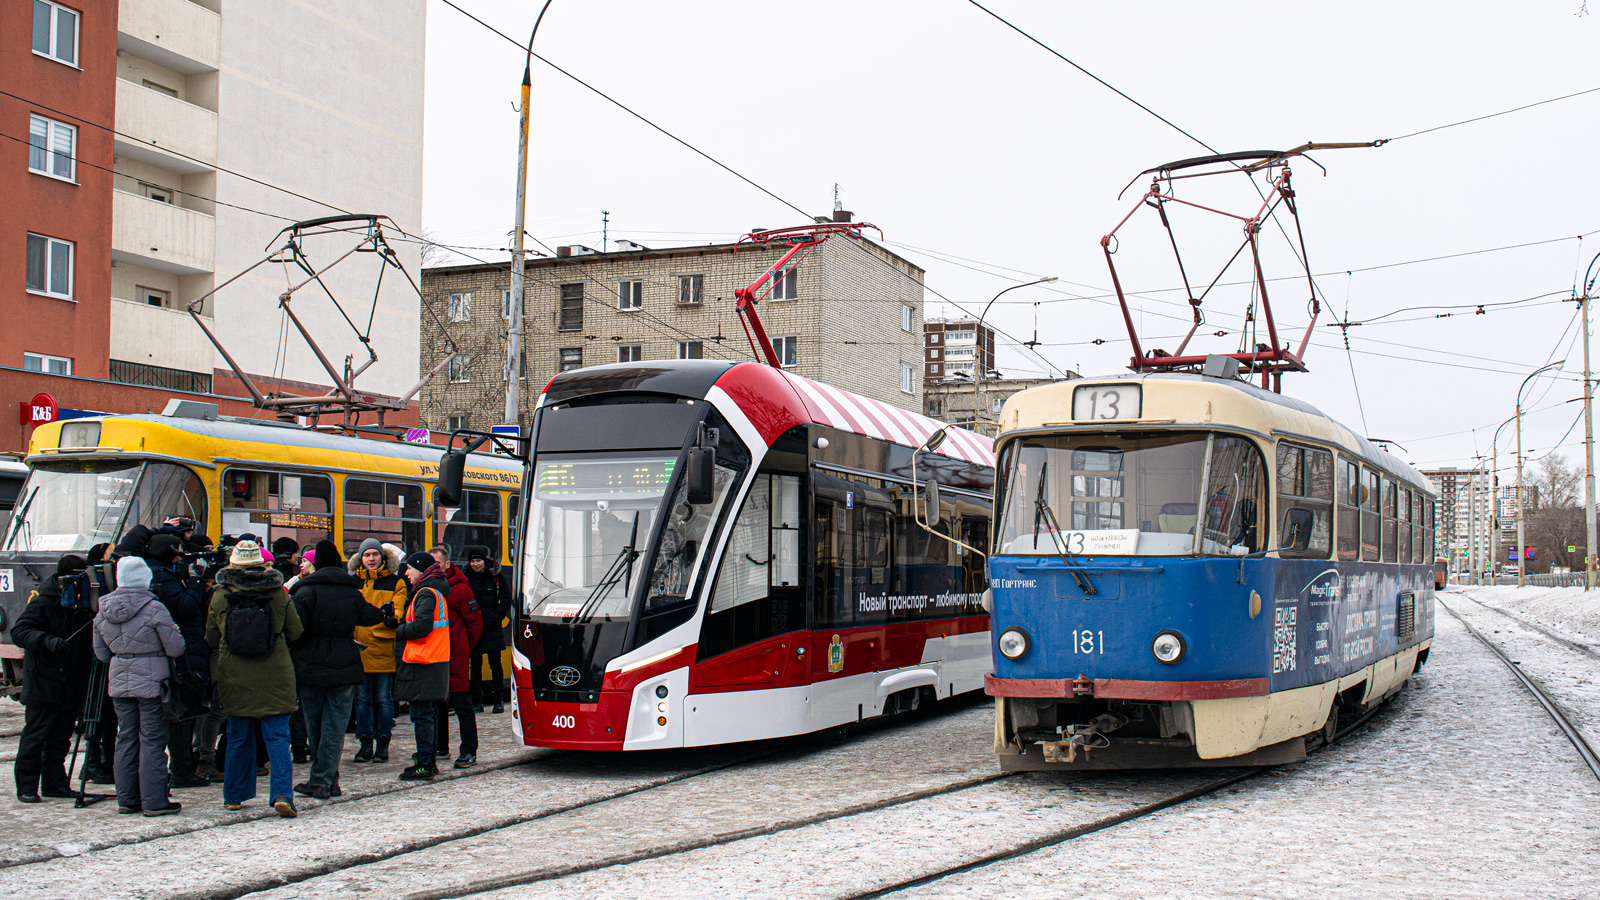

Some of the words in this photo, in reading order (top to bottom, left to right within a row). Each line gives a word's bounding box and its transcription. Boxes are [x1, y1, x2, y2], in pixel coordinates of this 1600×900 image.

[32, 405, 52, 421] К&Б
[1090, 390, 1121, 420] 13
[499, 473, 520, 484] 86/12
[1064, 532, 1086, 553] 13
[0, 574, 10, 591] 3
[859, 592, 887, 612] Новый
[888, 595, 928, 615] транспорт
[935, 589, 968, 610] любимому
[968, 592, 982, 609] горо
[1072, 629, 1104, 655] 181
[552, 715, 575, 729] 400
